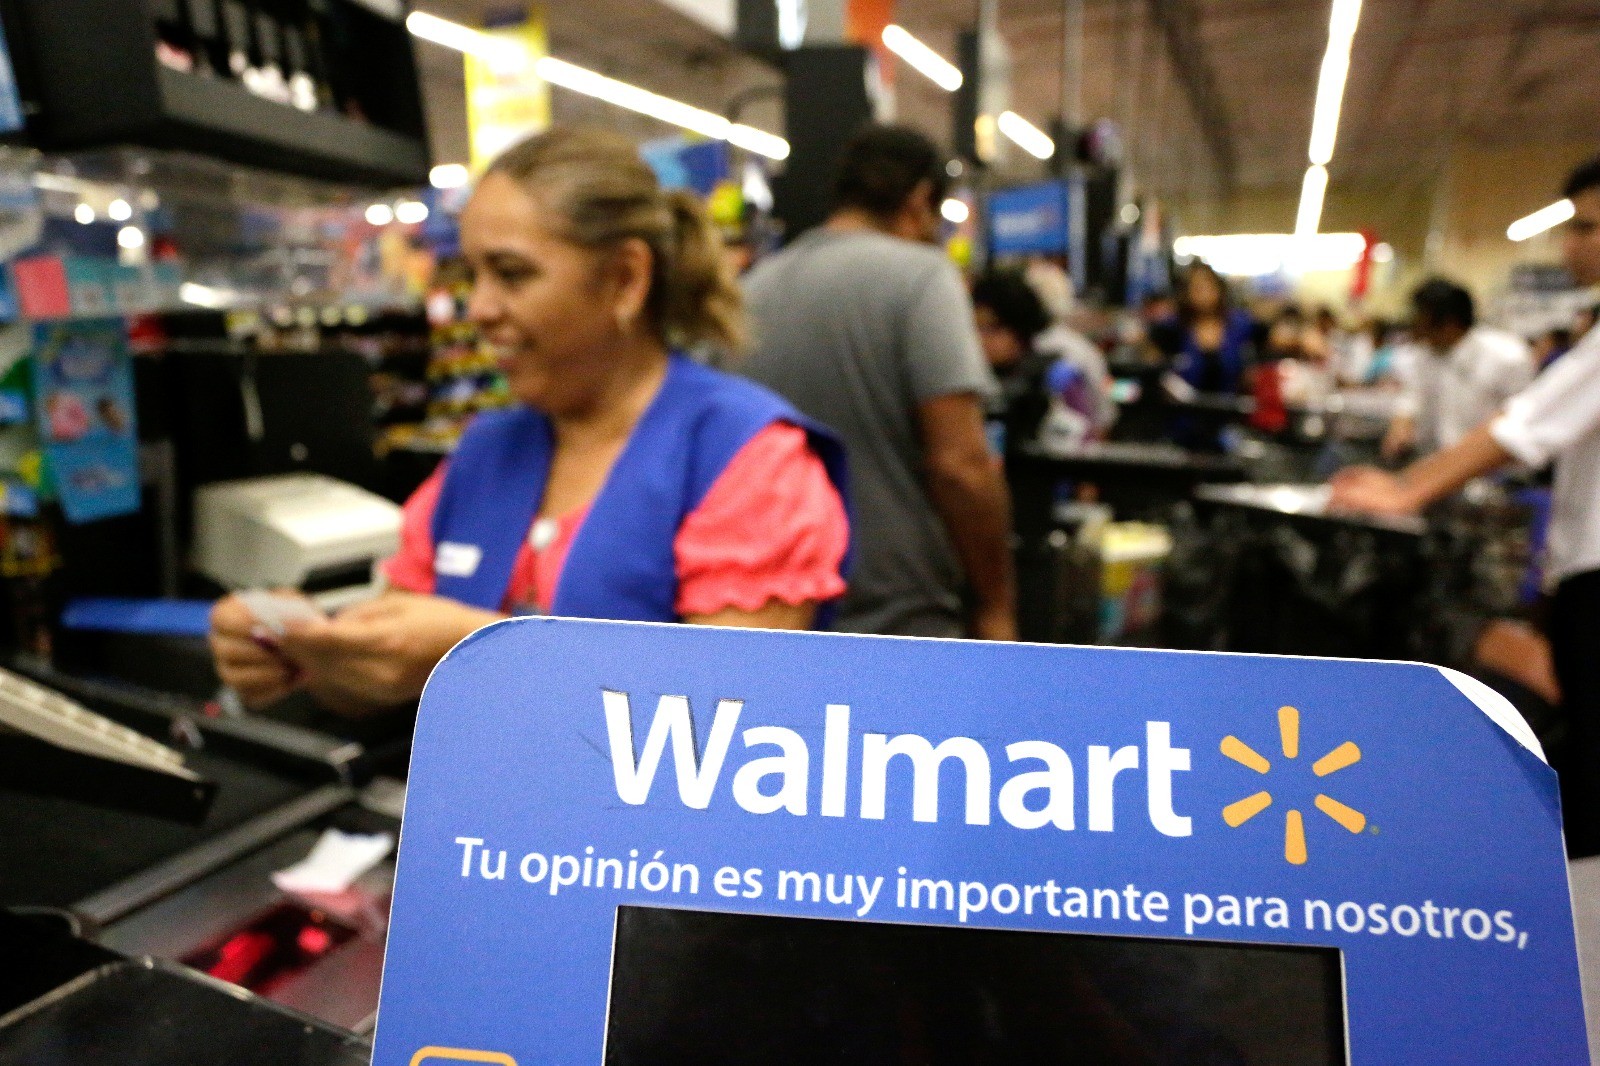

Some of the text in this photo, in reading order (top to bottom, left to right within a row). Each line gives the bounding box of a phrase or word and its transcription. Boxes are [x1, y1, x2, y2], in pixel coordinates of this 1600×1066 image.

[601, 690, 1193, 838] Walmart
[454, 836, 1529, 949] Tu opinión es muy importante para nosotros,
